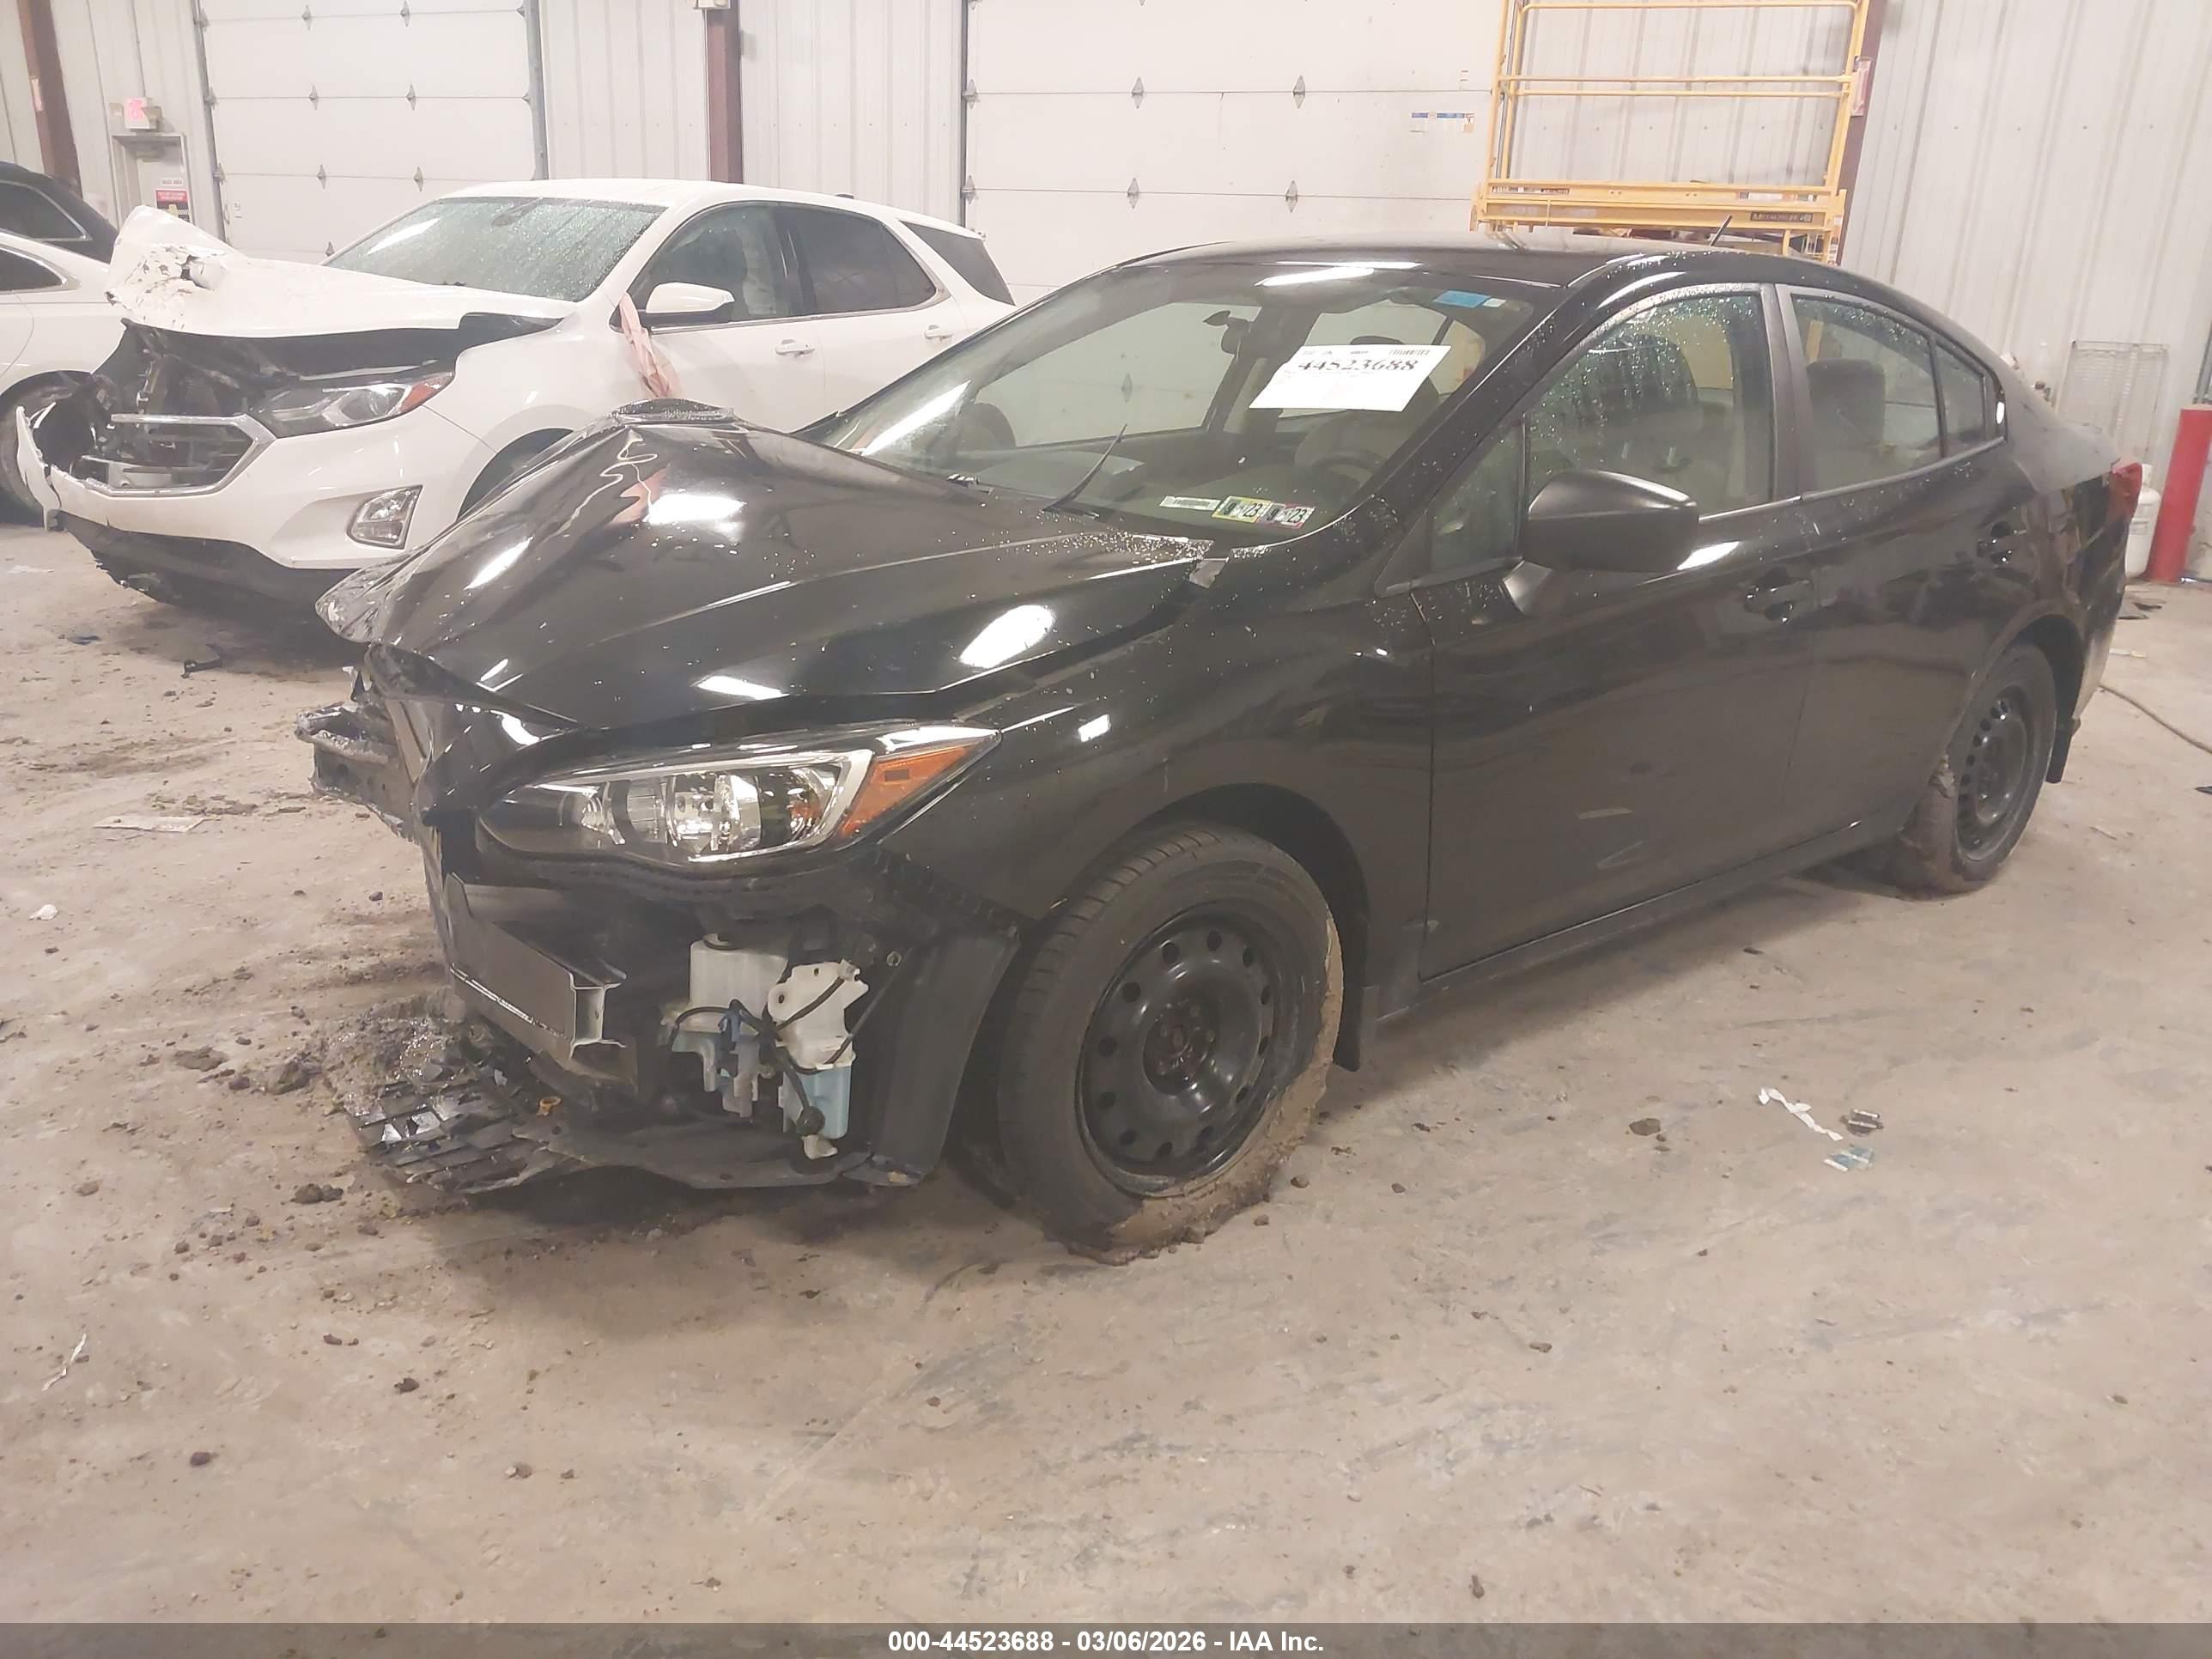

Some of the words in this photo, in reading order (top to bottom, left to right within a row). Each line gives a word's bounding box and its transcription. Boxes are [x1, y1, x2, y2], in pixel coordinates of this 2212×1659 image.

[1298, 358, 1419, 371] 44523688
[1243, 501, 1263, 518] 23
[1288, 507, 1308, 524] 23
